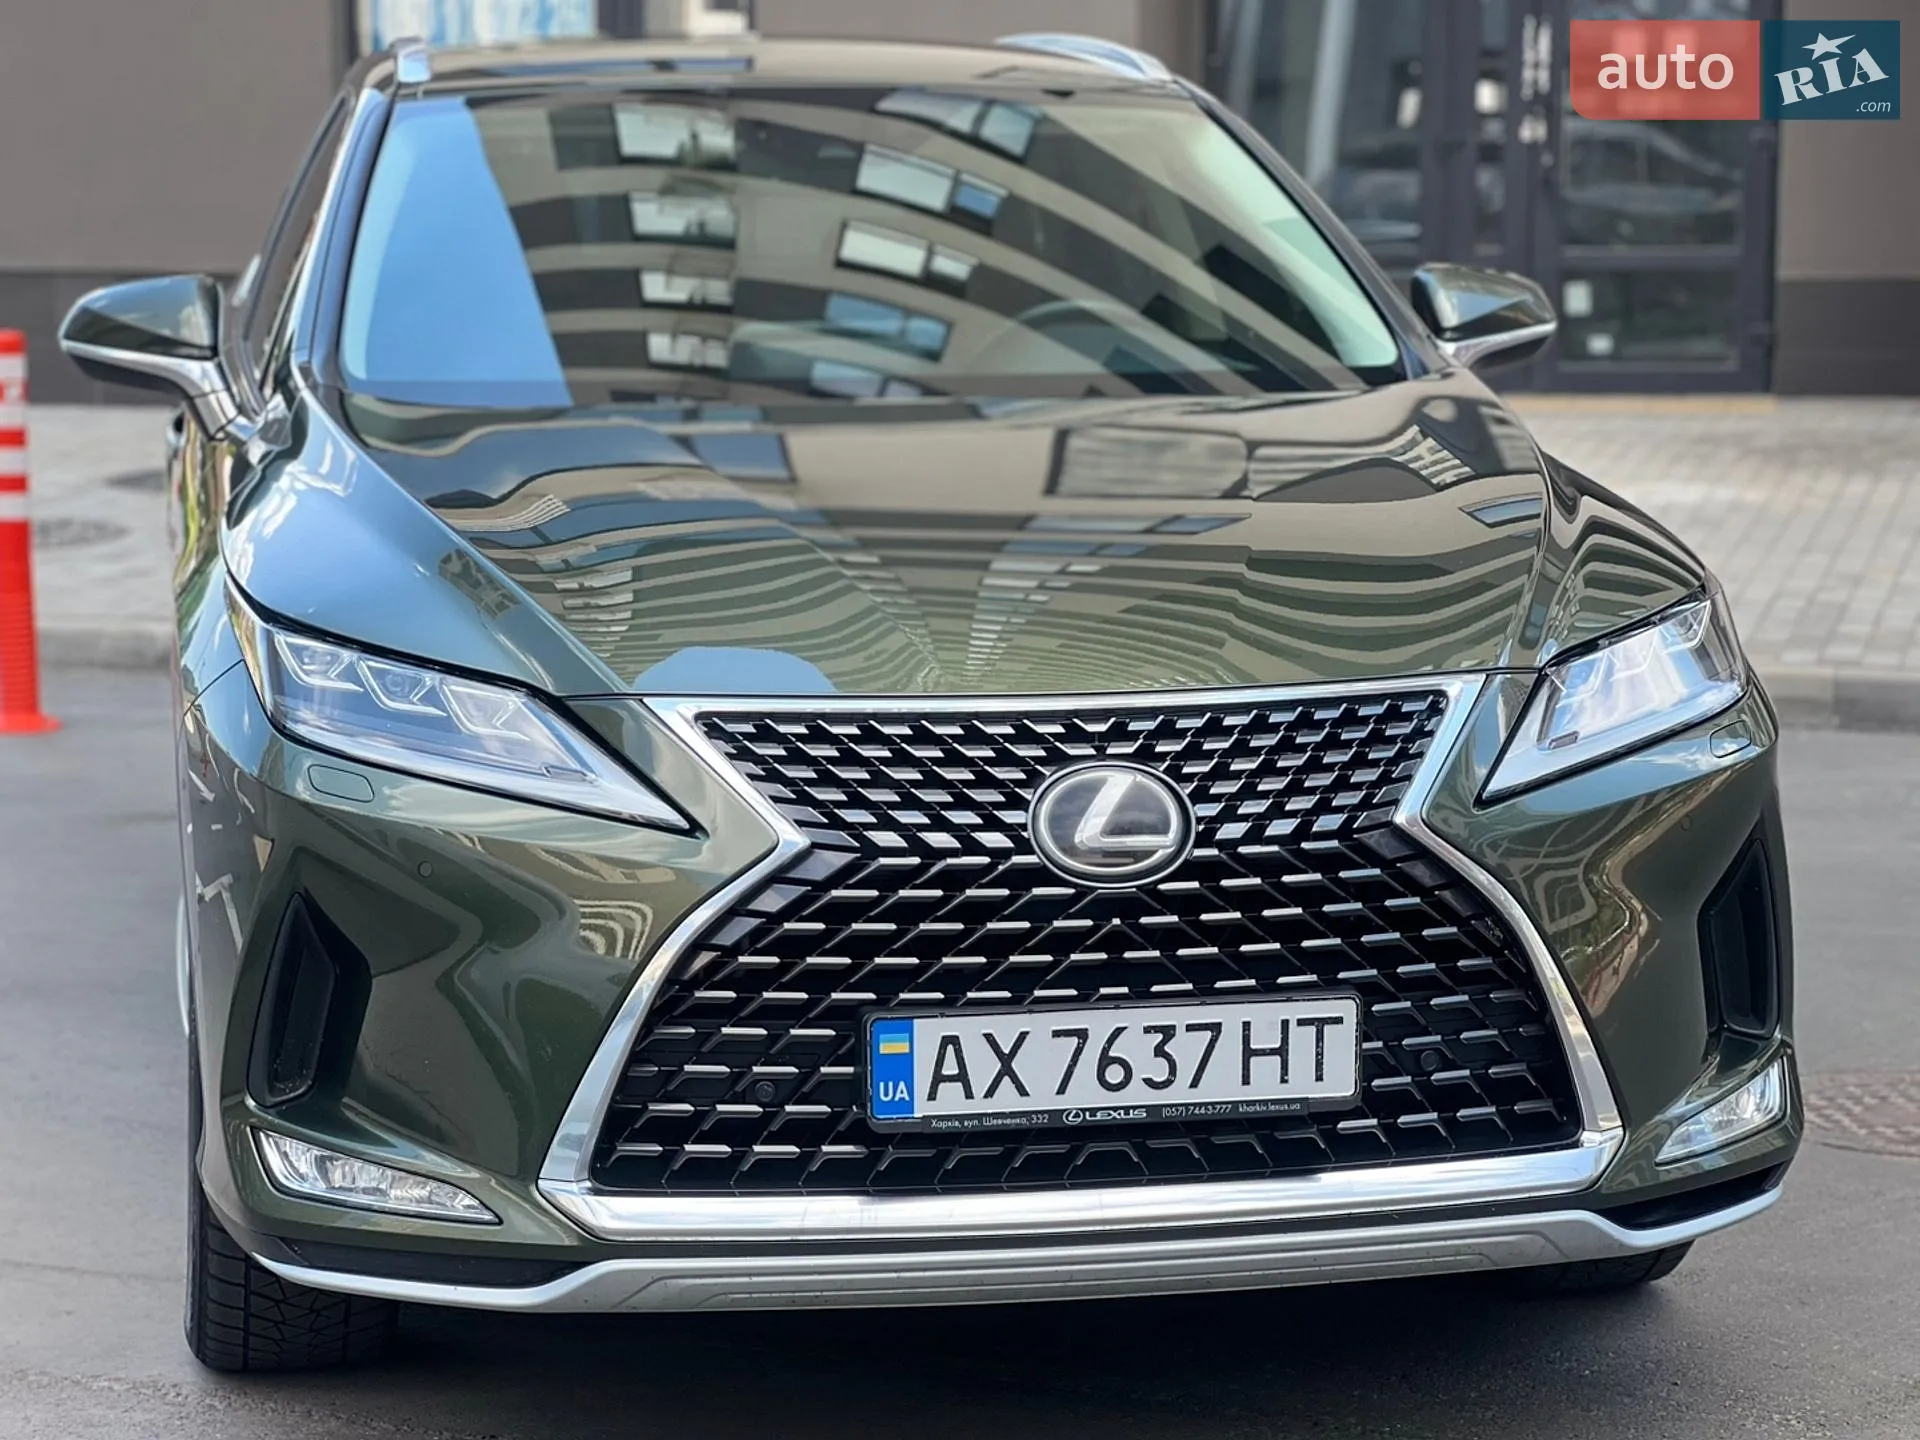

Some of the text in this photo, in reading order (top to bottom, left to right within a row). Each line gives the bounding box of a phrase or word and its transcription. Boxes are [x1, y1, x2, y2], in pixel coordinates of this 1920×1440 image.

[926, 1016, 1345, 1102] AX 7637 HT
[879, 1082, 910, 1102] UA
[1085, 1108, 1147, 1120] LEXUS
[1162, 1107, 1185, 1118] (057)
[1031, 1114, 1049, 1124] 332
